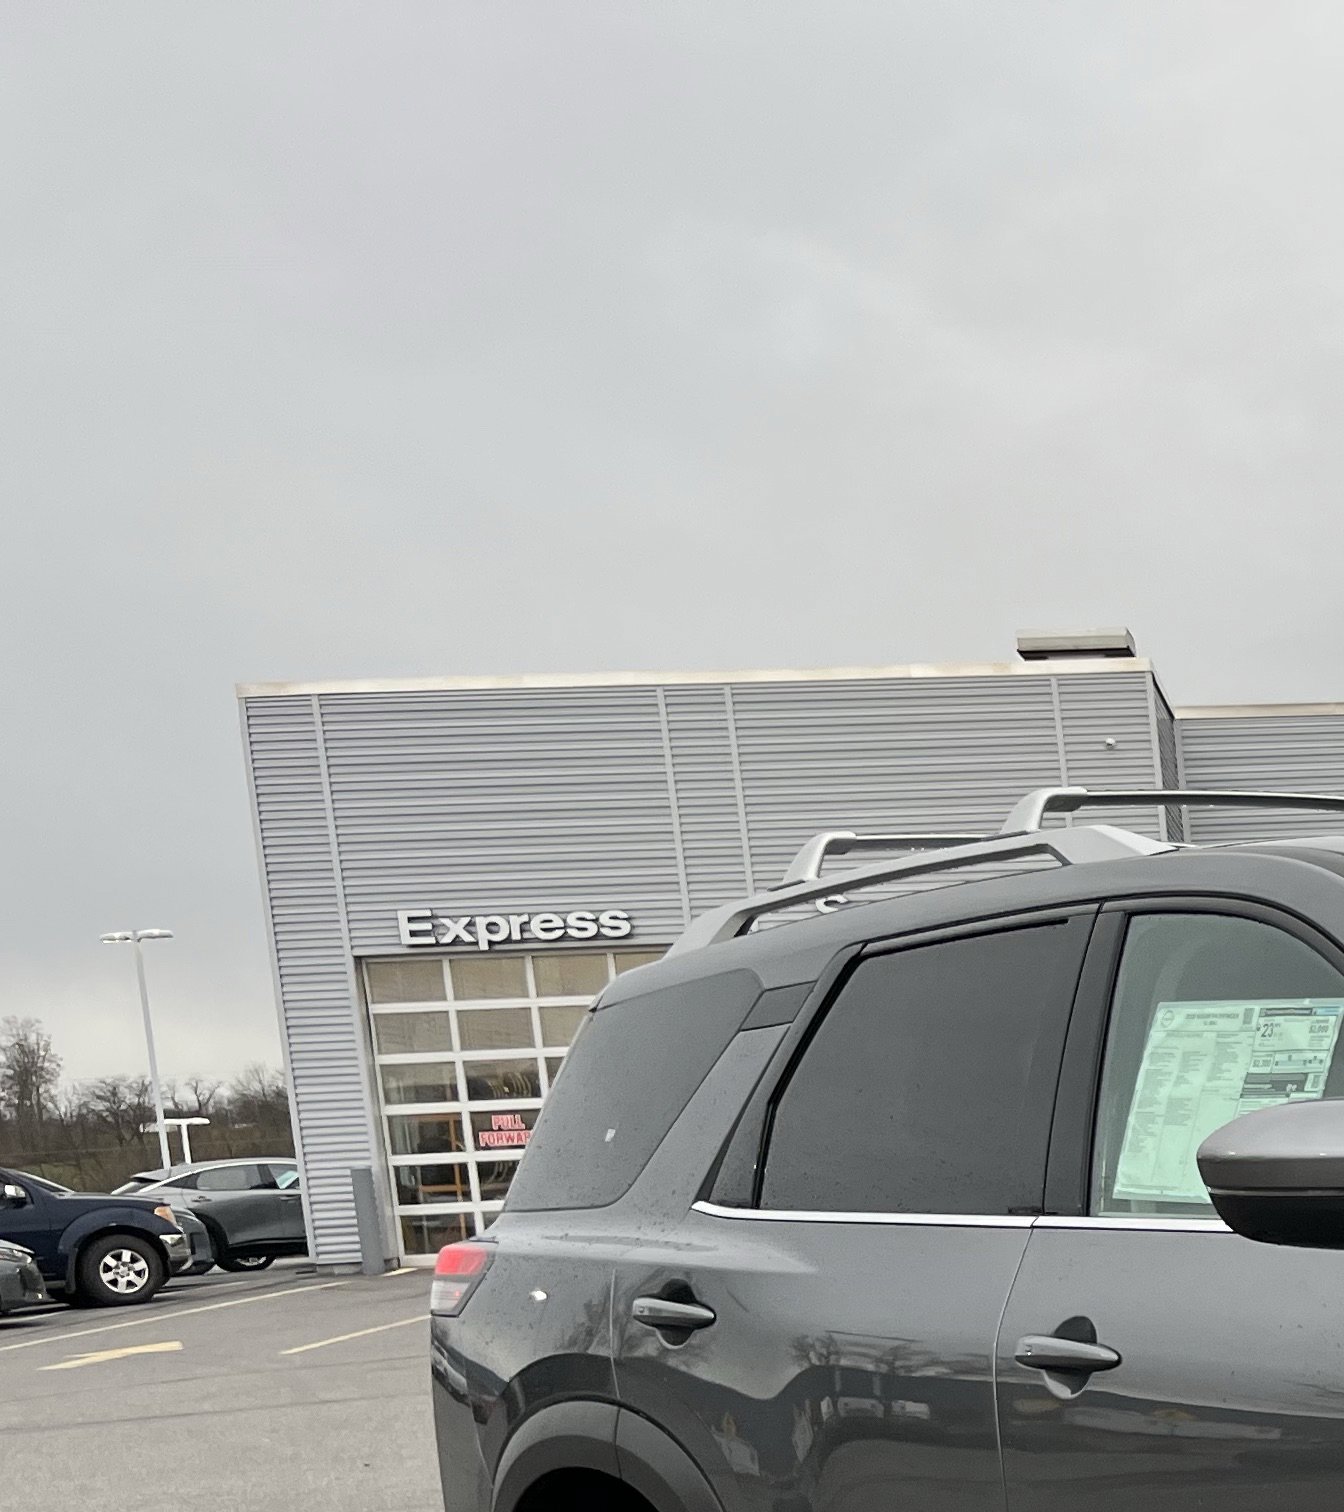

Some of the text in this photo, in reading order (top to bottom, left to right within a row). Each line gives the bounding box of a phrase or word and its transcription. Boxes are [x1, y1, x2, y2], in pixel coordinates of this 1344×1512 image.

[397, 908, 632, 951] Express
[491, 1114, 526, 1131] PULL
[478, 1130, 533, 1147] FORWAR
